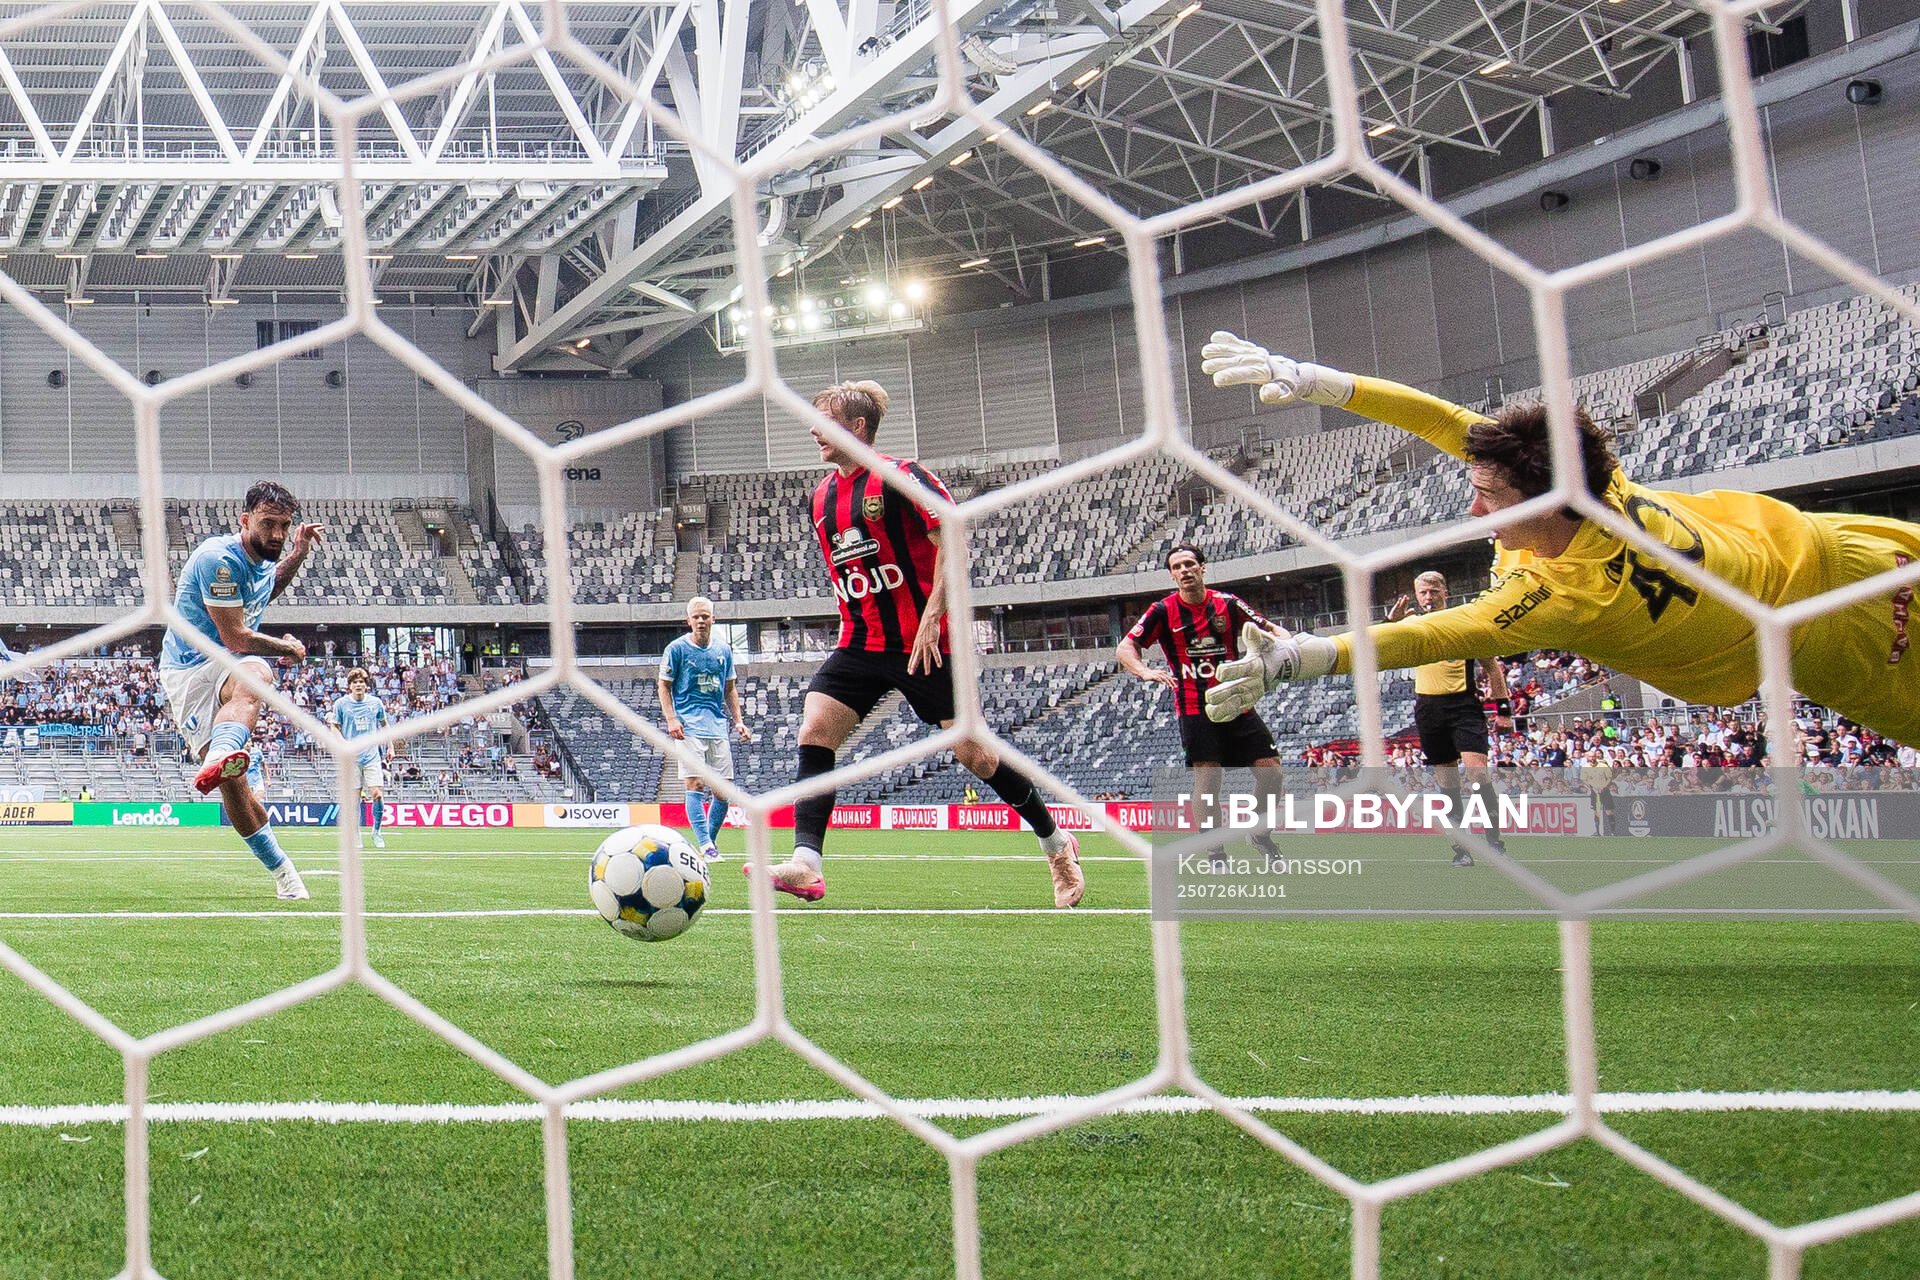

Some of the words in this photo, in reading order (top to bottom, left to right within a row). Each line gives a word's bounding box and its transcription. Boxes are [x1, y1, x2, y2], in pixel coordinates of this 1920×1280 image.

[562, 467, 601, 481] rena
[832, 564, 904, 606] NÖJD
[0, 804, 34, 819] ÄDER
[380, 804, 509, 826] BEVEGO
[831, 809, 872, 825] BAUHAUS
[892, 809, 937, 825] BAUHAUS
[958, 808, 1009, 826] BAUHAUS
